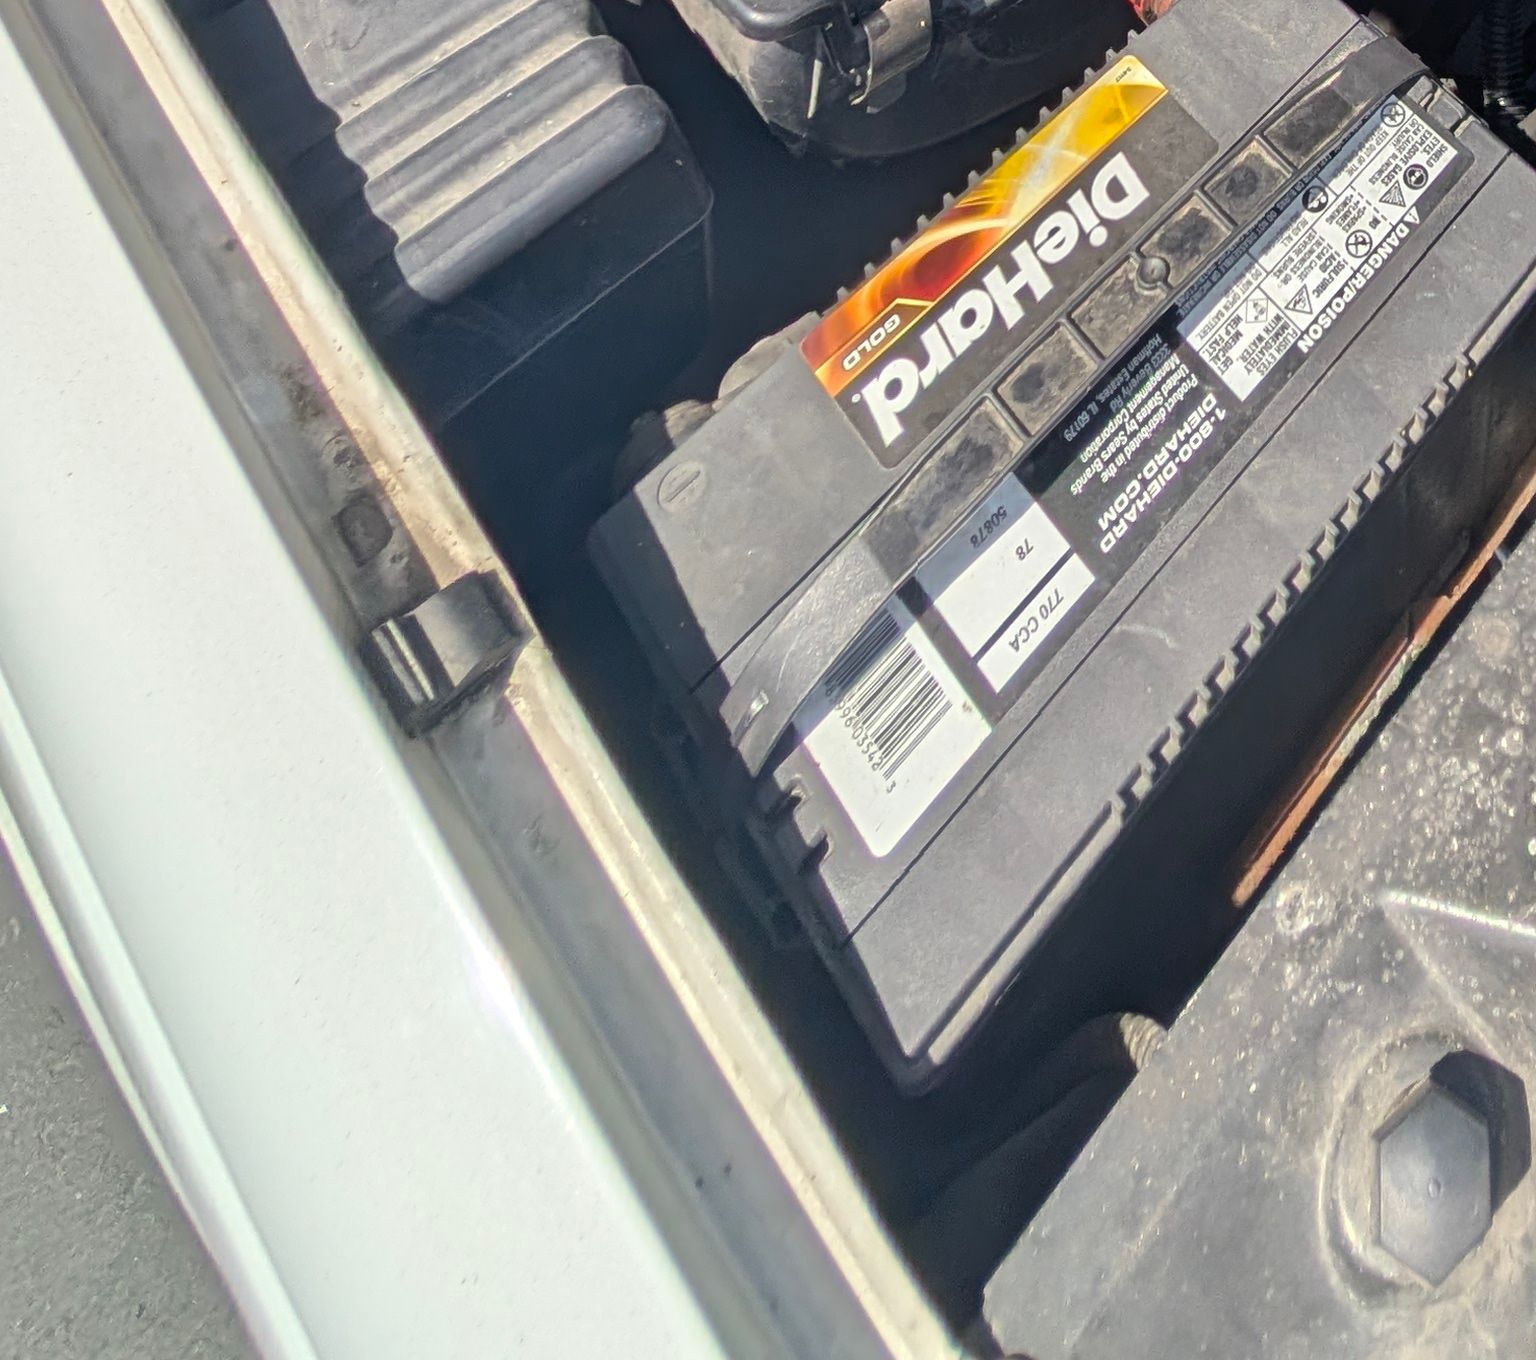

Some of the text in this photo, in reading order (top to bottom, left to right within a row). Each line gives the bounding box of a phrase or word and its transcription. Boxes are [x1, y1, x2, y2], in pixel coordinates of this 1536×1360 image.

[1367, 153, 1399, 184] BLINDNESS
[1380, 130, 1433, 186] EXPLOSIVE GASES
[1424, 143, 1449, 167] SHIELD
[1289, 239, 1322, 274] BLINDNESS
[1291, 233, 1315, 257] SEVERE
[1317, 253, 1337, 273] ACID
[1296, 259, 1317, 282] CAUSE
[1297, 223, 1410, 353] DANGER/POISON
[1311, 261, 1345, 297] SULFURIC
[1222, 292, 1241, 312] OPEN
[842, 312, 901, 372] GOLD
[1222, 314, 1242, 335] HELP
[1235, 312, 1283, 365] WITH WATER.
[1127, 331, 1161, 372] Hoffman
[1201, 334, 1224, 359] FAST.
[1209, 329, 1242, 365] MEDICAL
[1216, 355, 1233, 374] GET
[1242, 321, 1290, 373] IMMEDIATELY
[1255, 327, 1298, 376] FLUSH EYES
[1120, 360, 1152, 400] Beverly
[1079, 350, 1179, 465] Management Corporation
[1086, 400, 1099, 415] IL
[1109, 394, 1124, 413] Rd
[1069, 363, 1188, 496] United States by Sears Brands
[1098, 372, 1198, 485] Product distributed in the
[1099, 394, 1214, 528] DIEHARD.COM
[1013, 538, 1033, 560] 78
[1007, 588, 1064, 652] 770 CCA
